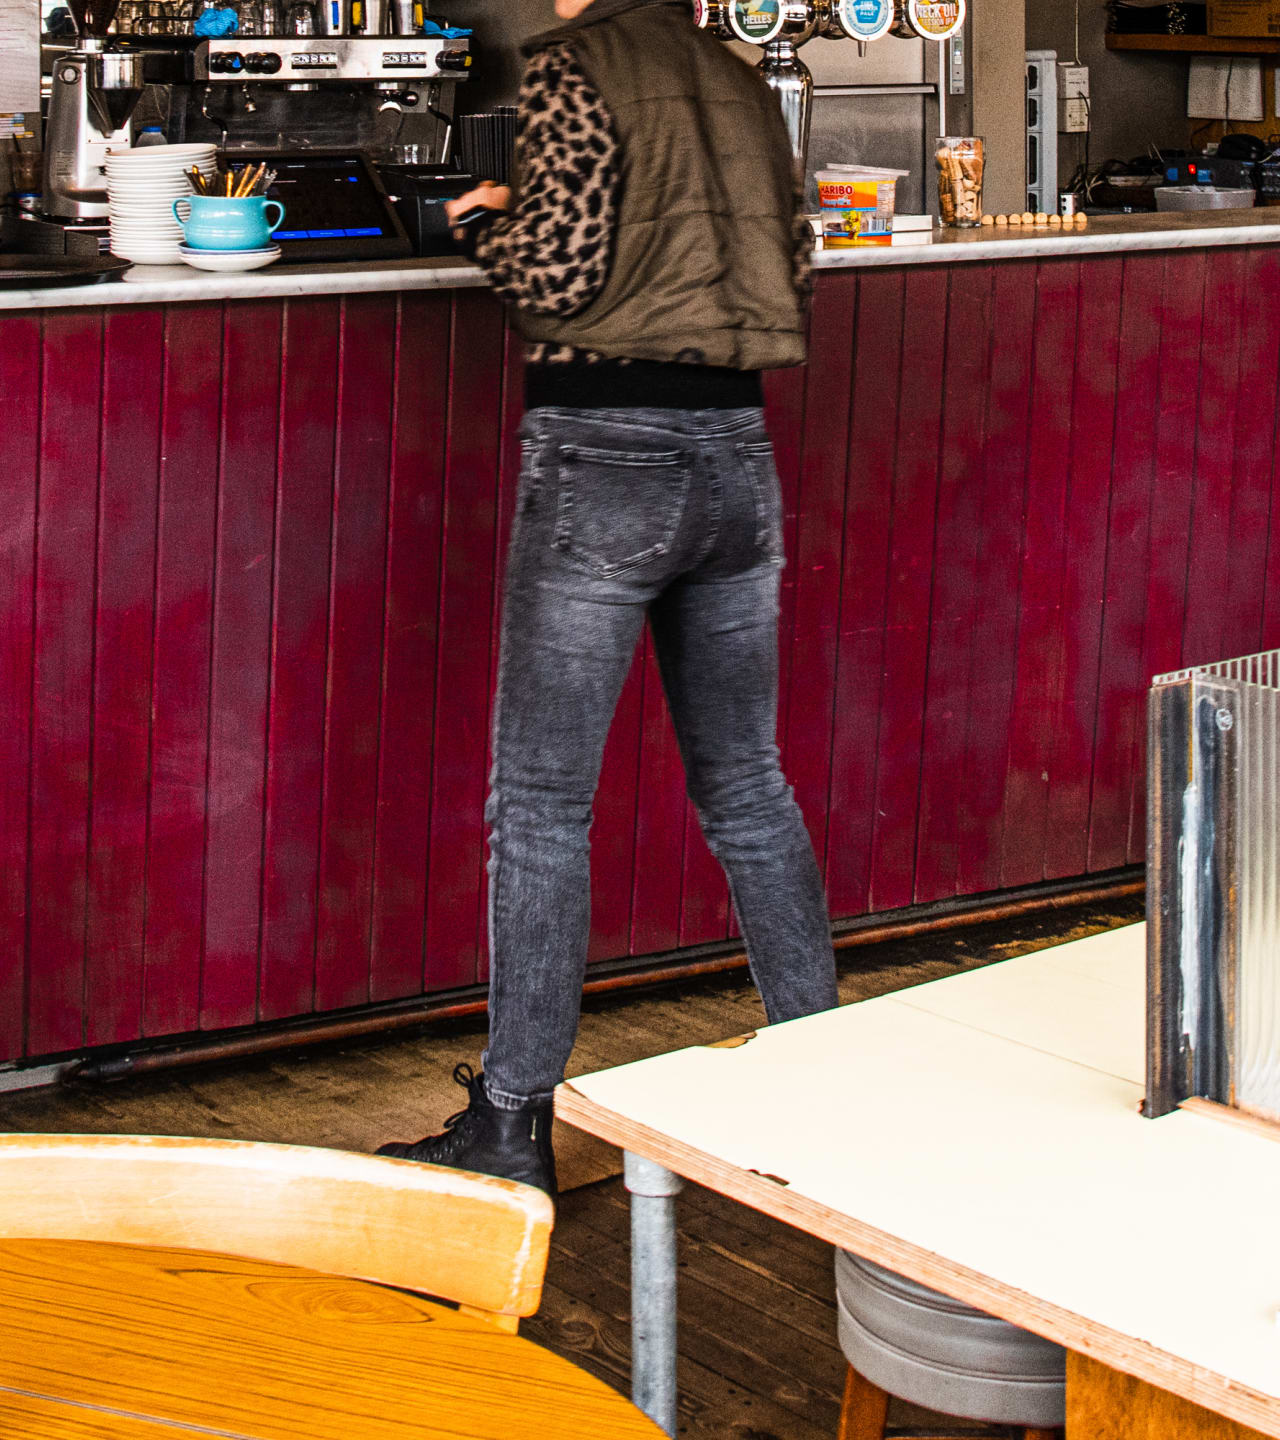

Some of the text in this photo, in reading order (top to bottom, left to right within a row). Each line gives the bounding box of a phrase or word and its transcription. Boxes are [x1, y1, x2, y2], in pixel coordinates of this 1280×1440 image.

[916, 2, 958, 18] NECK OIL
[742, 13, 774, 25] HELLES
